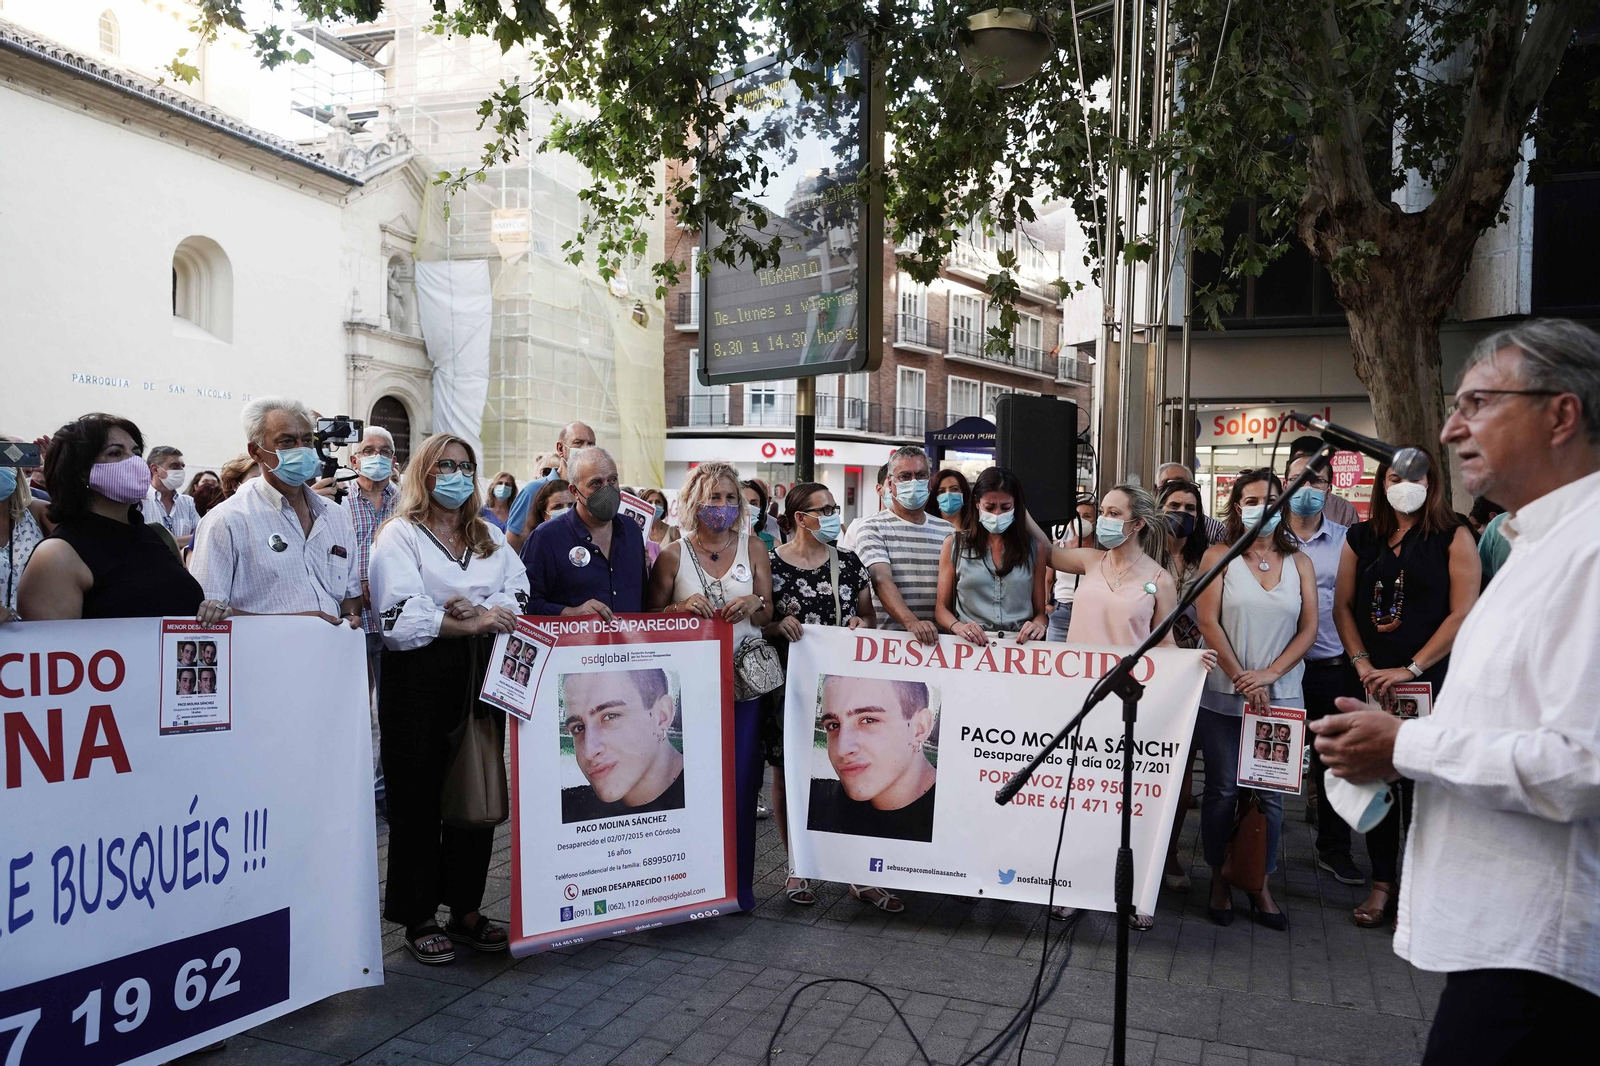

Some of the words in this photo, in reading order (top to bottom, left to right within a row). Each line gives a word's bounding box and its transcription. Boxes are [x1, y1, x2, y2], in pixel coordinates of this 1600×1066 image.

[759, 261, 819, 287] HORARIO
[784, 303, 792, 315] a
[714, 340, 743, 357] 8.30
[752, 341, 760, 353] a
[768, 331, 807, 351] 14.30
[72, 373, 130, 388] PARROQUIA
[144, 382, 155, 391] DE
[168, 384, 186, 394] SAN
[197, 388, 232, 400] NICOLAS
[781, 447, 834, 458] voone
[1333, 456, 1338, 465] 2
[1338, 455, 1358, 465] GAFAS
[539, 620, 589, 635] MENOR
[593, 617, 700, 633] DESAPARECIDO
[853, 636, 1156, 683] DESAPARECIDO
[960, 726, 1016, 746] PACO
[4, 704, 132, 789] NA
[974, 748, 1062, 765] Desaparedo
[1066, 756, 1078, 766] el
[1082, 756, 1102, 768] día
[1134, 782, 1162, 798] 710
[1050, 796, 1074, 810] 661
[1082, 798, 1108, 813] 471
[1116, 802, 1143, 816] 92
[576, 824, 598, 834] PACO
[599, 819, 630, 832] MOLINA
[632, 814, 668, 826] SÁNCHEZ
[557, 838, 600, 850] Desaparecido
[607, 832, 644, 844] 02/07/2015
[654, 827, 680, 836] Córdoba
[51, 794, 230, 926] BUSQUÉIS
[616, 848, 632, 856] años
[555, 872, 578, 880] Teléfono
[579, 866, 608, 877] confidencial
[622, 862, 641, 870] familia:
[642, 852, 686, 866] 689950710
[886, 864, 967, 878] sebuscapacomolinasanchez
[582, 886, 608, 896] MENOR
[608, 876, 662, 892] DESAPARECIDO
[663, 872, 687, 882] 116000
[628, 900, 639, 908] 112
[72, 977, 151, 1046] 19
[174, 947, 242, 1012] 62
